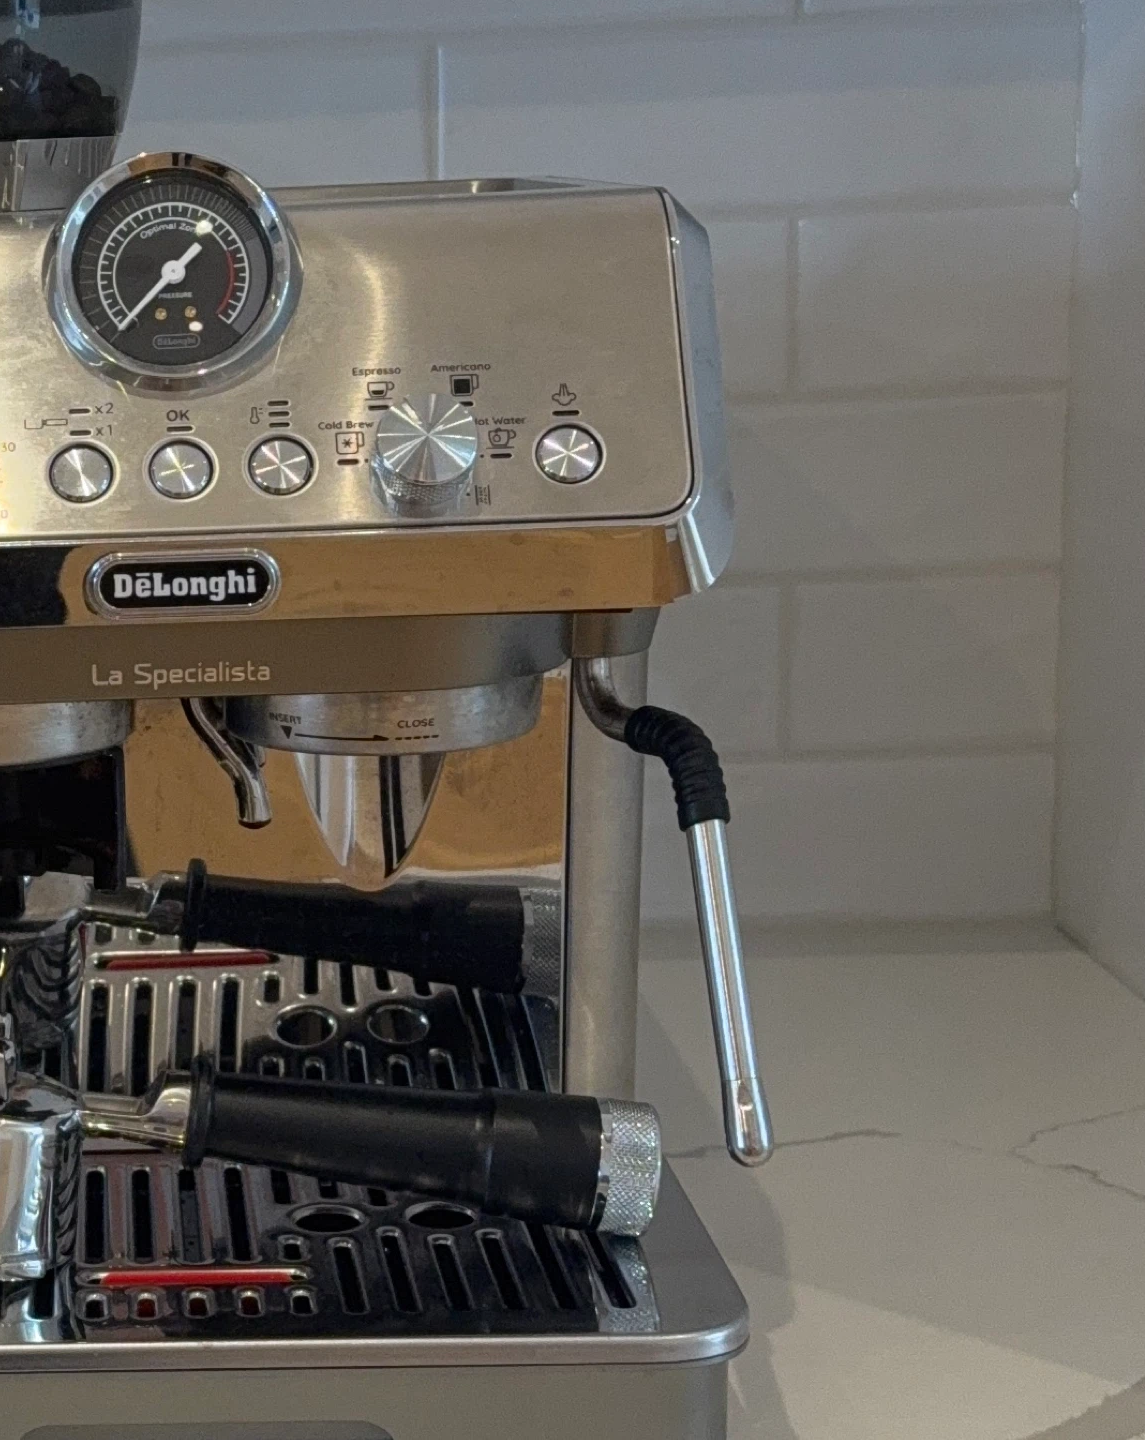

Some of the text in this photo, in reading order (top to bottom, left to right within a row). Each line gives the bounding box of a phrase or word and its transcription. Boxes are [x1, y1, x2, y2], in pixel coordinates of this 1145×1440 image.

[139, 222, 177, 239] Optimal
[351, 366, 401, 377] Espresso
[430, 363, 491, 373] Americano
[166, 410, 190, 422] OK
[491, 416, 526, 425] Water
[318, 420, 374, 430] Cold Brew
[2, 442, 16, 452] 30
[91, 660, 271, 691] La Specialista
[268, 712, 302, 725] INSERT
[397, 718, 435, 729] CLOSE
